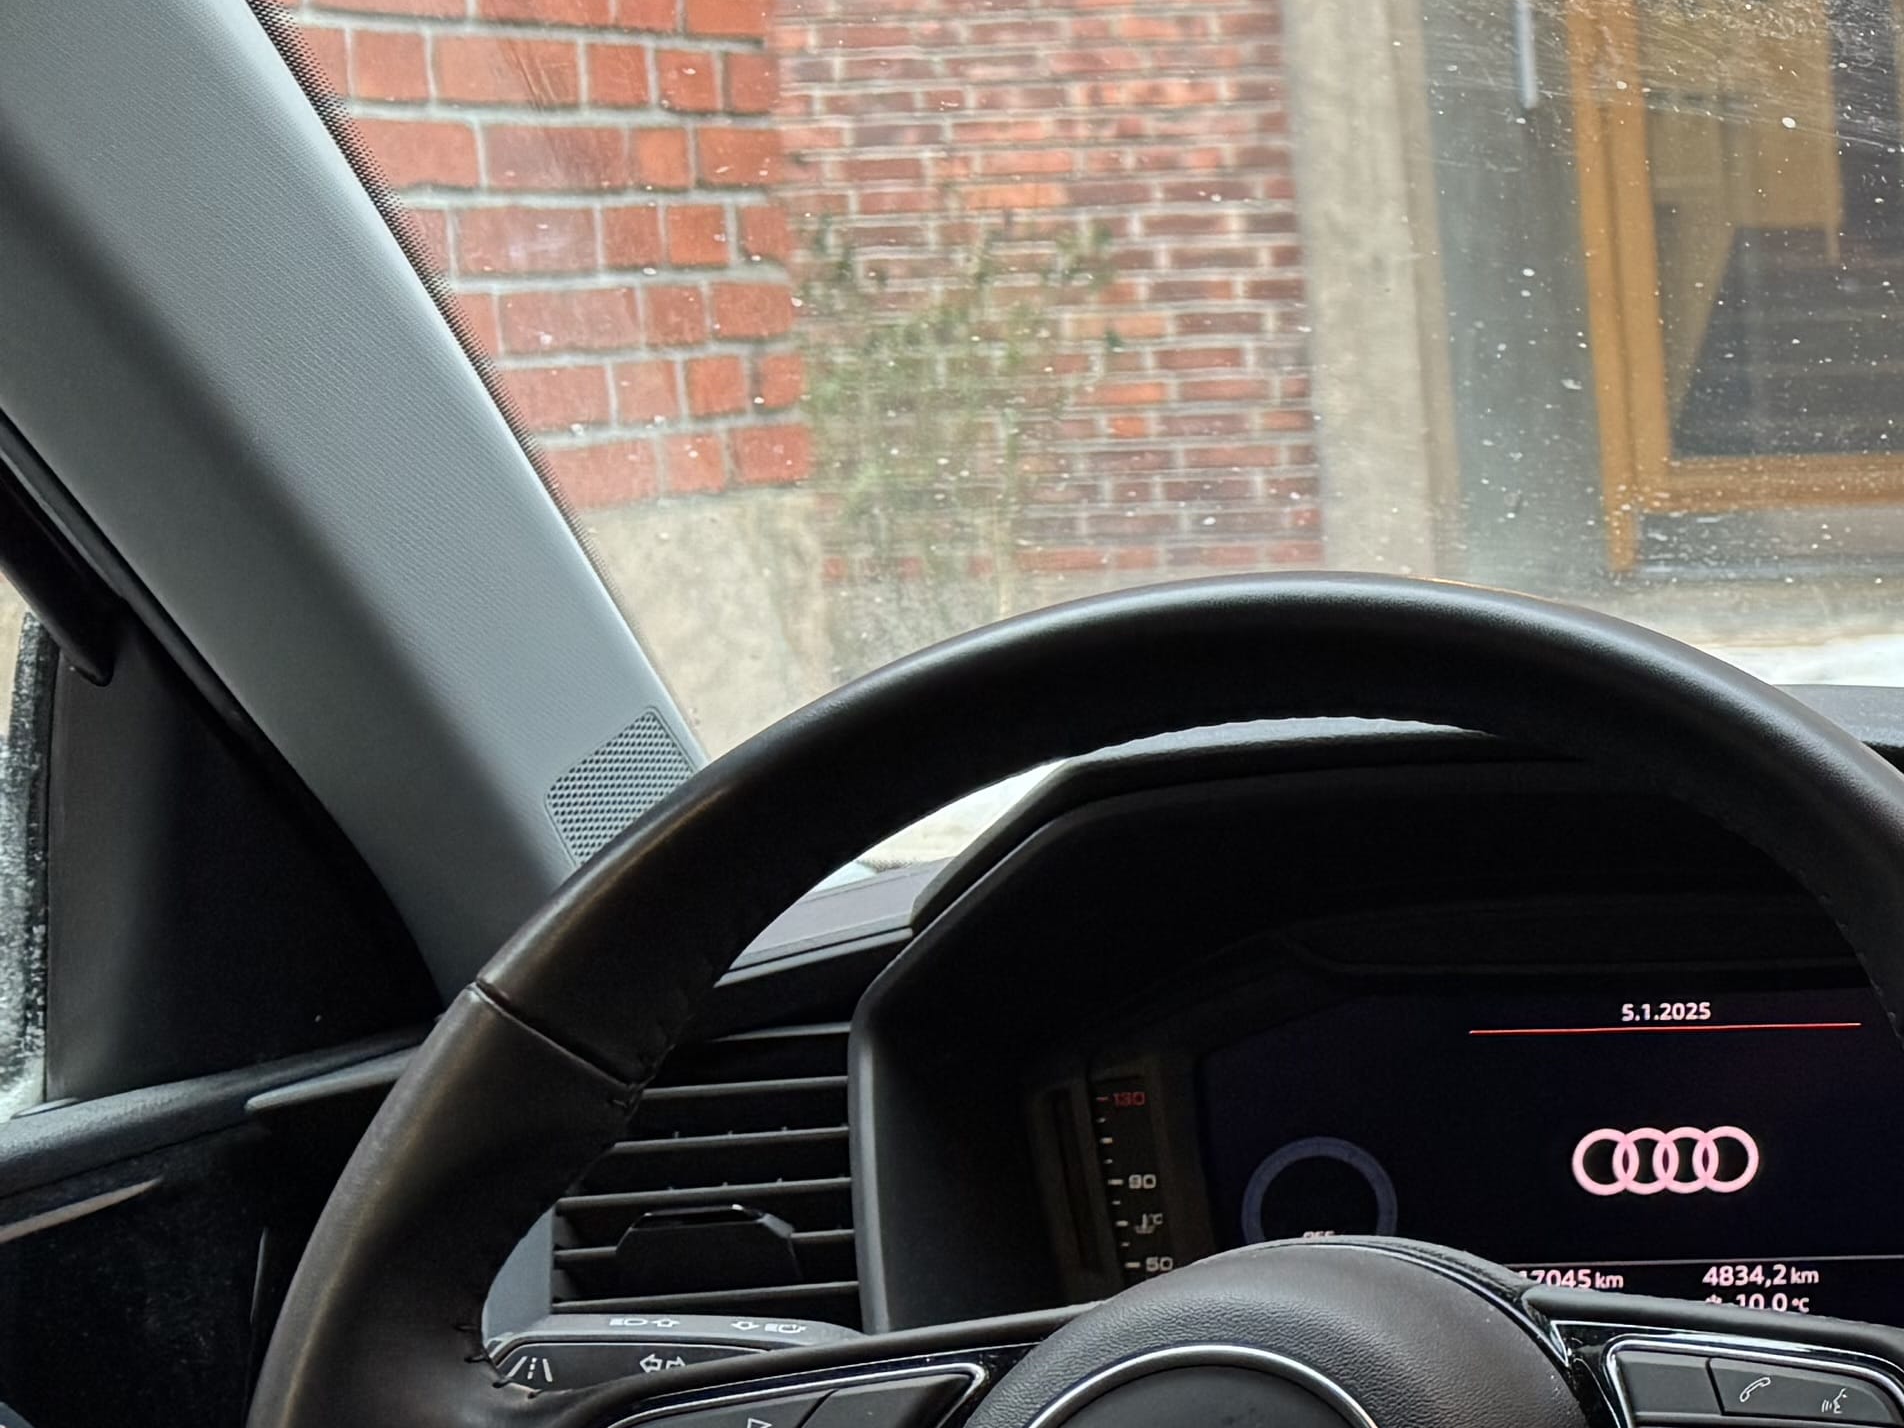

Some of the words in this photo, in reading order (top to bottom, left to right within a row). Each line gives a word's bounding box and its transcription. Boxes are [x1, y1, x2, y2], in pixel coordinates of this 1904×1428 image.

[1621, 1002, 1712, 1022] 5.1.2025
[1113, 1091, 1145, 1106] 130
[1128, 1174, 1156, 1189] 90
[1146, 1257, 1173, 1271] 50
[1595, 1272, 1624, 1289] km
[1702, 1264, 1787, 1288] 4834,2
[1790, 1266, 1820, 1284] km
